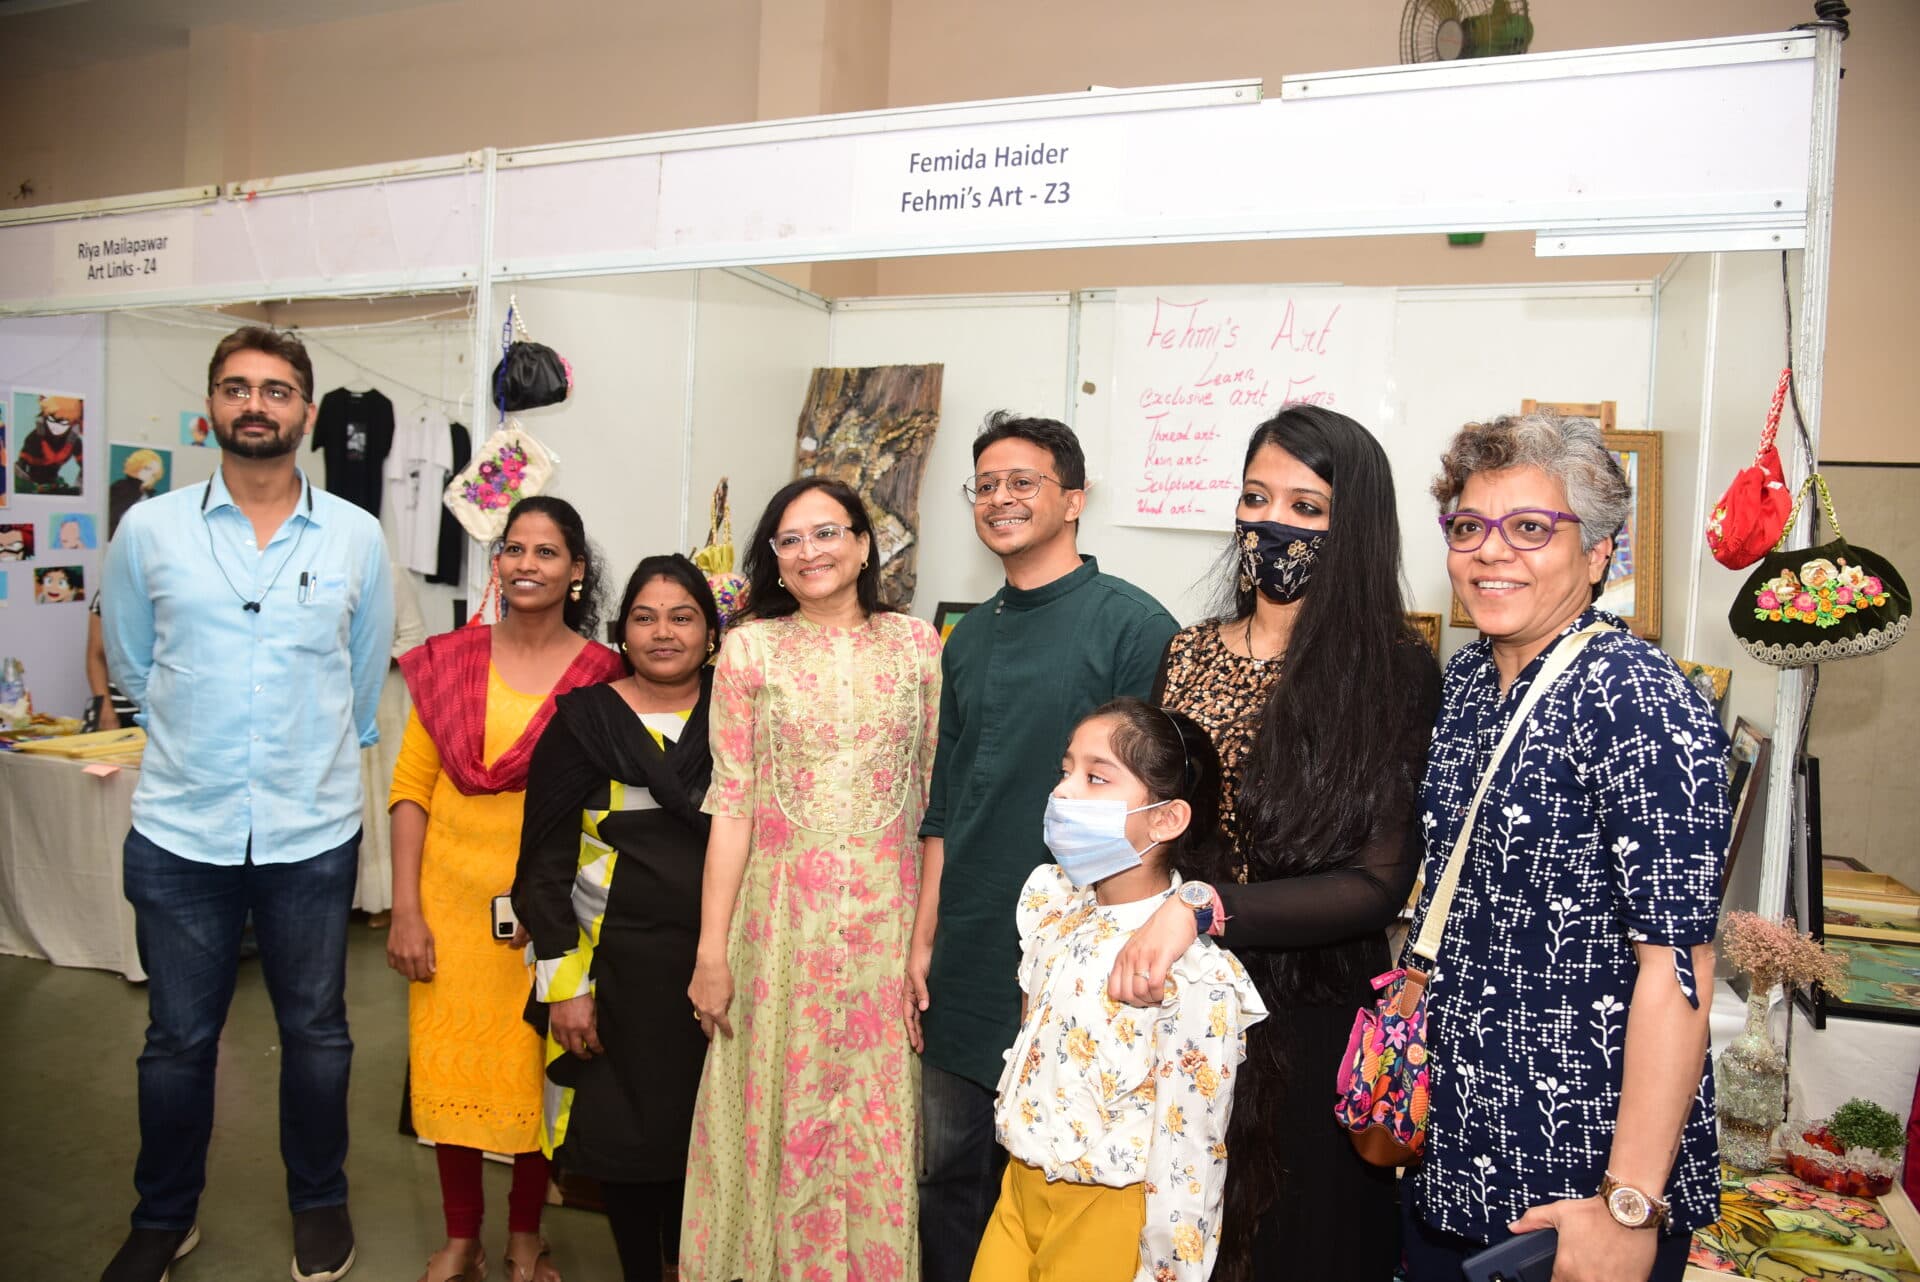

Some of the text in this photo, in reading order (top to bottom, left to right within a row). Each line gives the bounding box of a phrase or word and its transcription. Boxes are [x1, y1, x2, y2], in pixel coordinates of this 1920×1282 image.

[909, 142, 1069, 174] Femida Haider
[988, 186, 1023, 207] Art
[1044, 181, 1071, 204] Z3
[78, 236, 168, 261] Riya Mailapawar
[87, 264, 104, 280] Art
[107, 260, 134, 279] Links
[143, 258, 157, 275] Z4
[1271, 297, 1341, 355] Art
[1194, 351, 1255, 387] Learn
[1229, 380, 1269, 407] art
[1145, 411, 1193, 442] Thread
